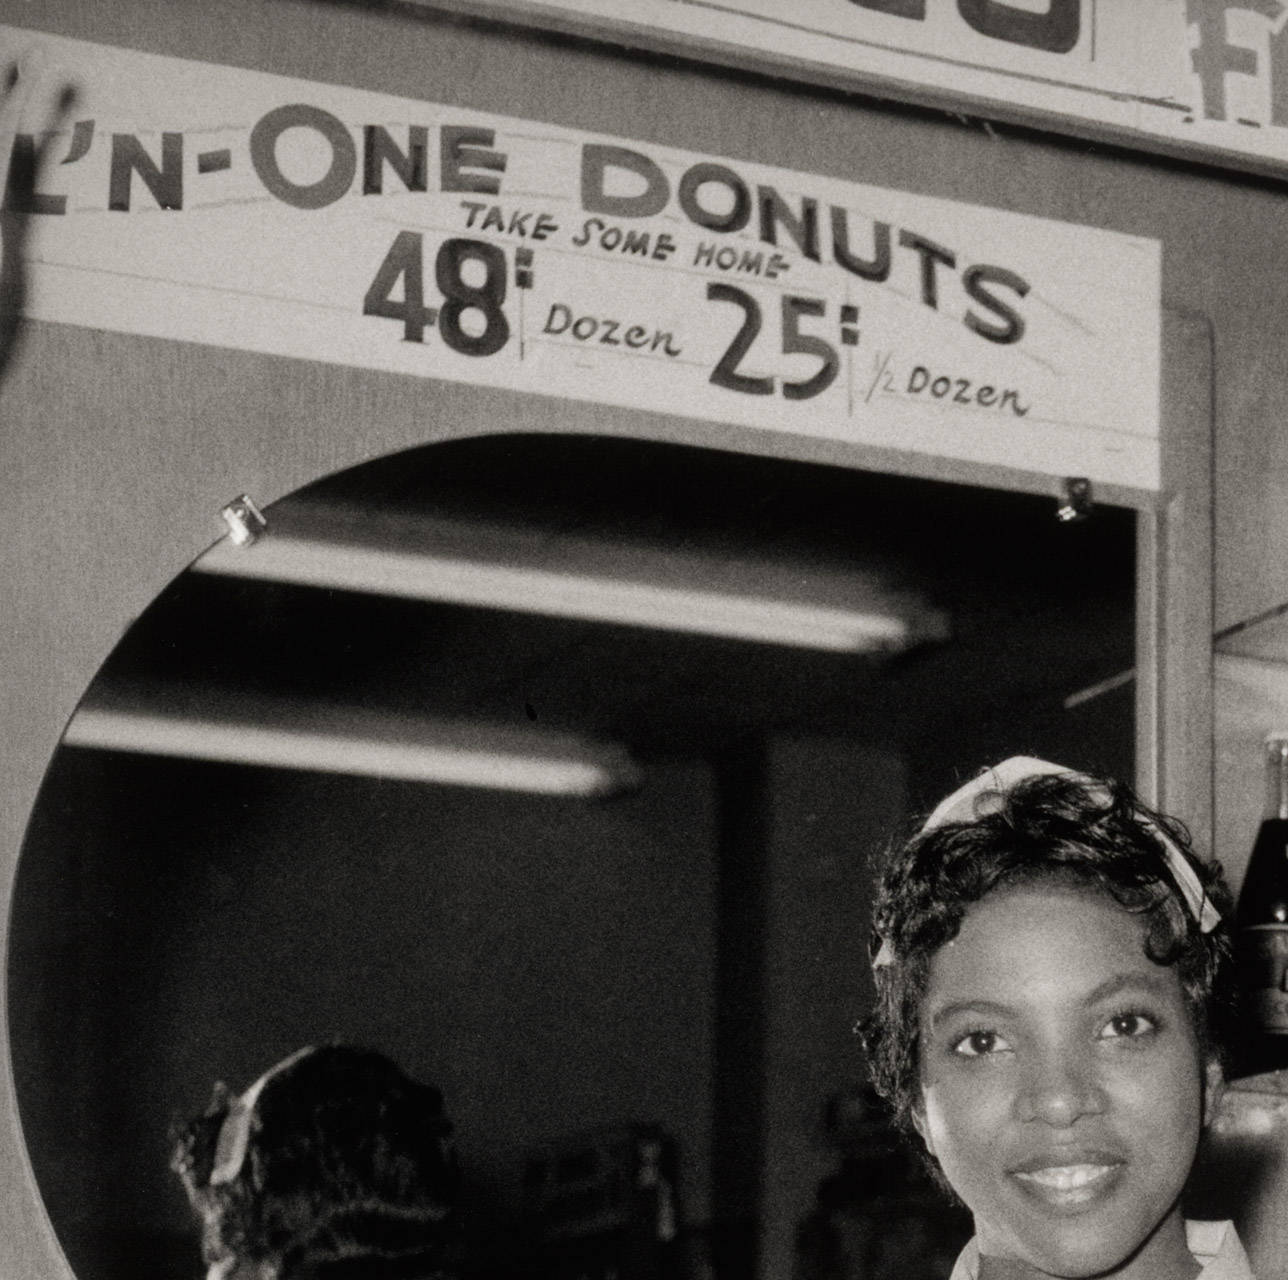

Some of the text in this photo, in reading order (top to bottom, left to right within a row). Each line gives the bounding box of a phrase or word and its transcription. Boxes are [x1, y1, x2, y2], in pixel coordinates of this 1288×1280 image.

[459, 201, 790, 281] TAKE SOME HOME
[580, 143, 1031, 345] DONUTS
[542, 303, 682, 358] Dozen
[906, 366, 1029, 417] Dozen
